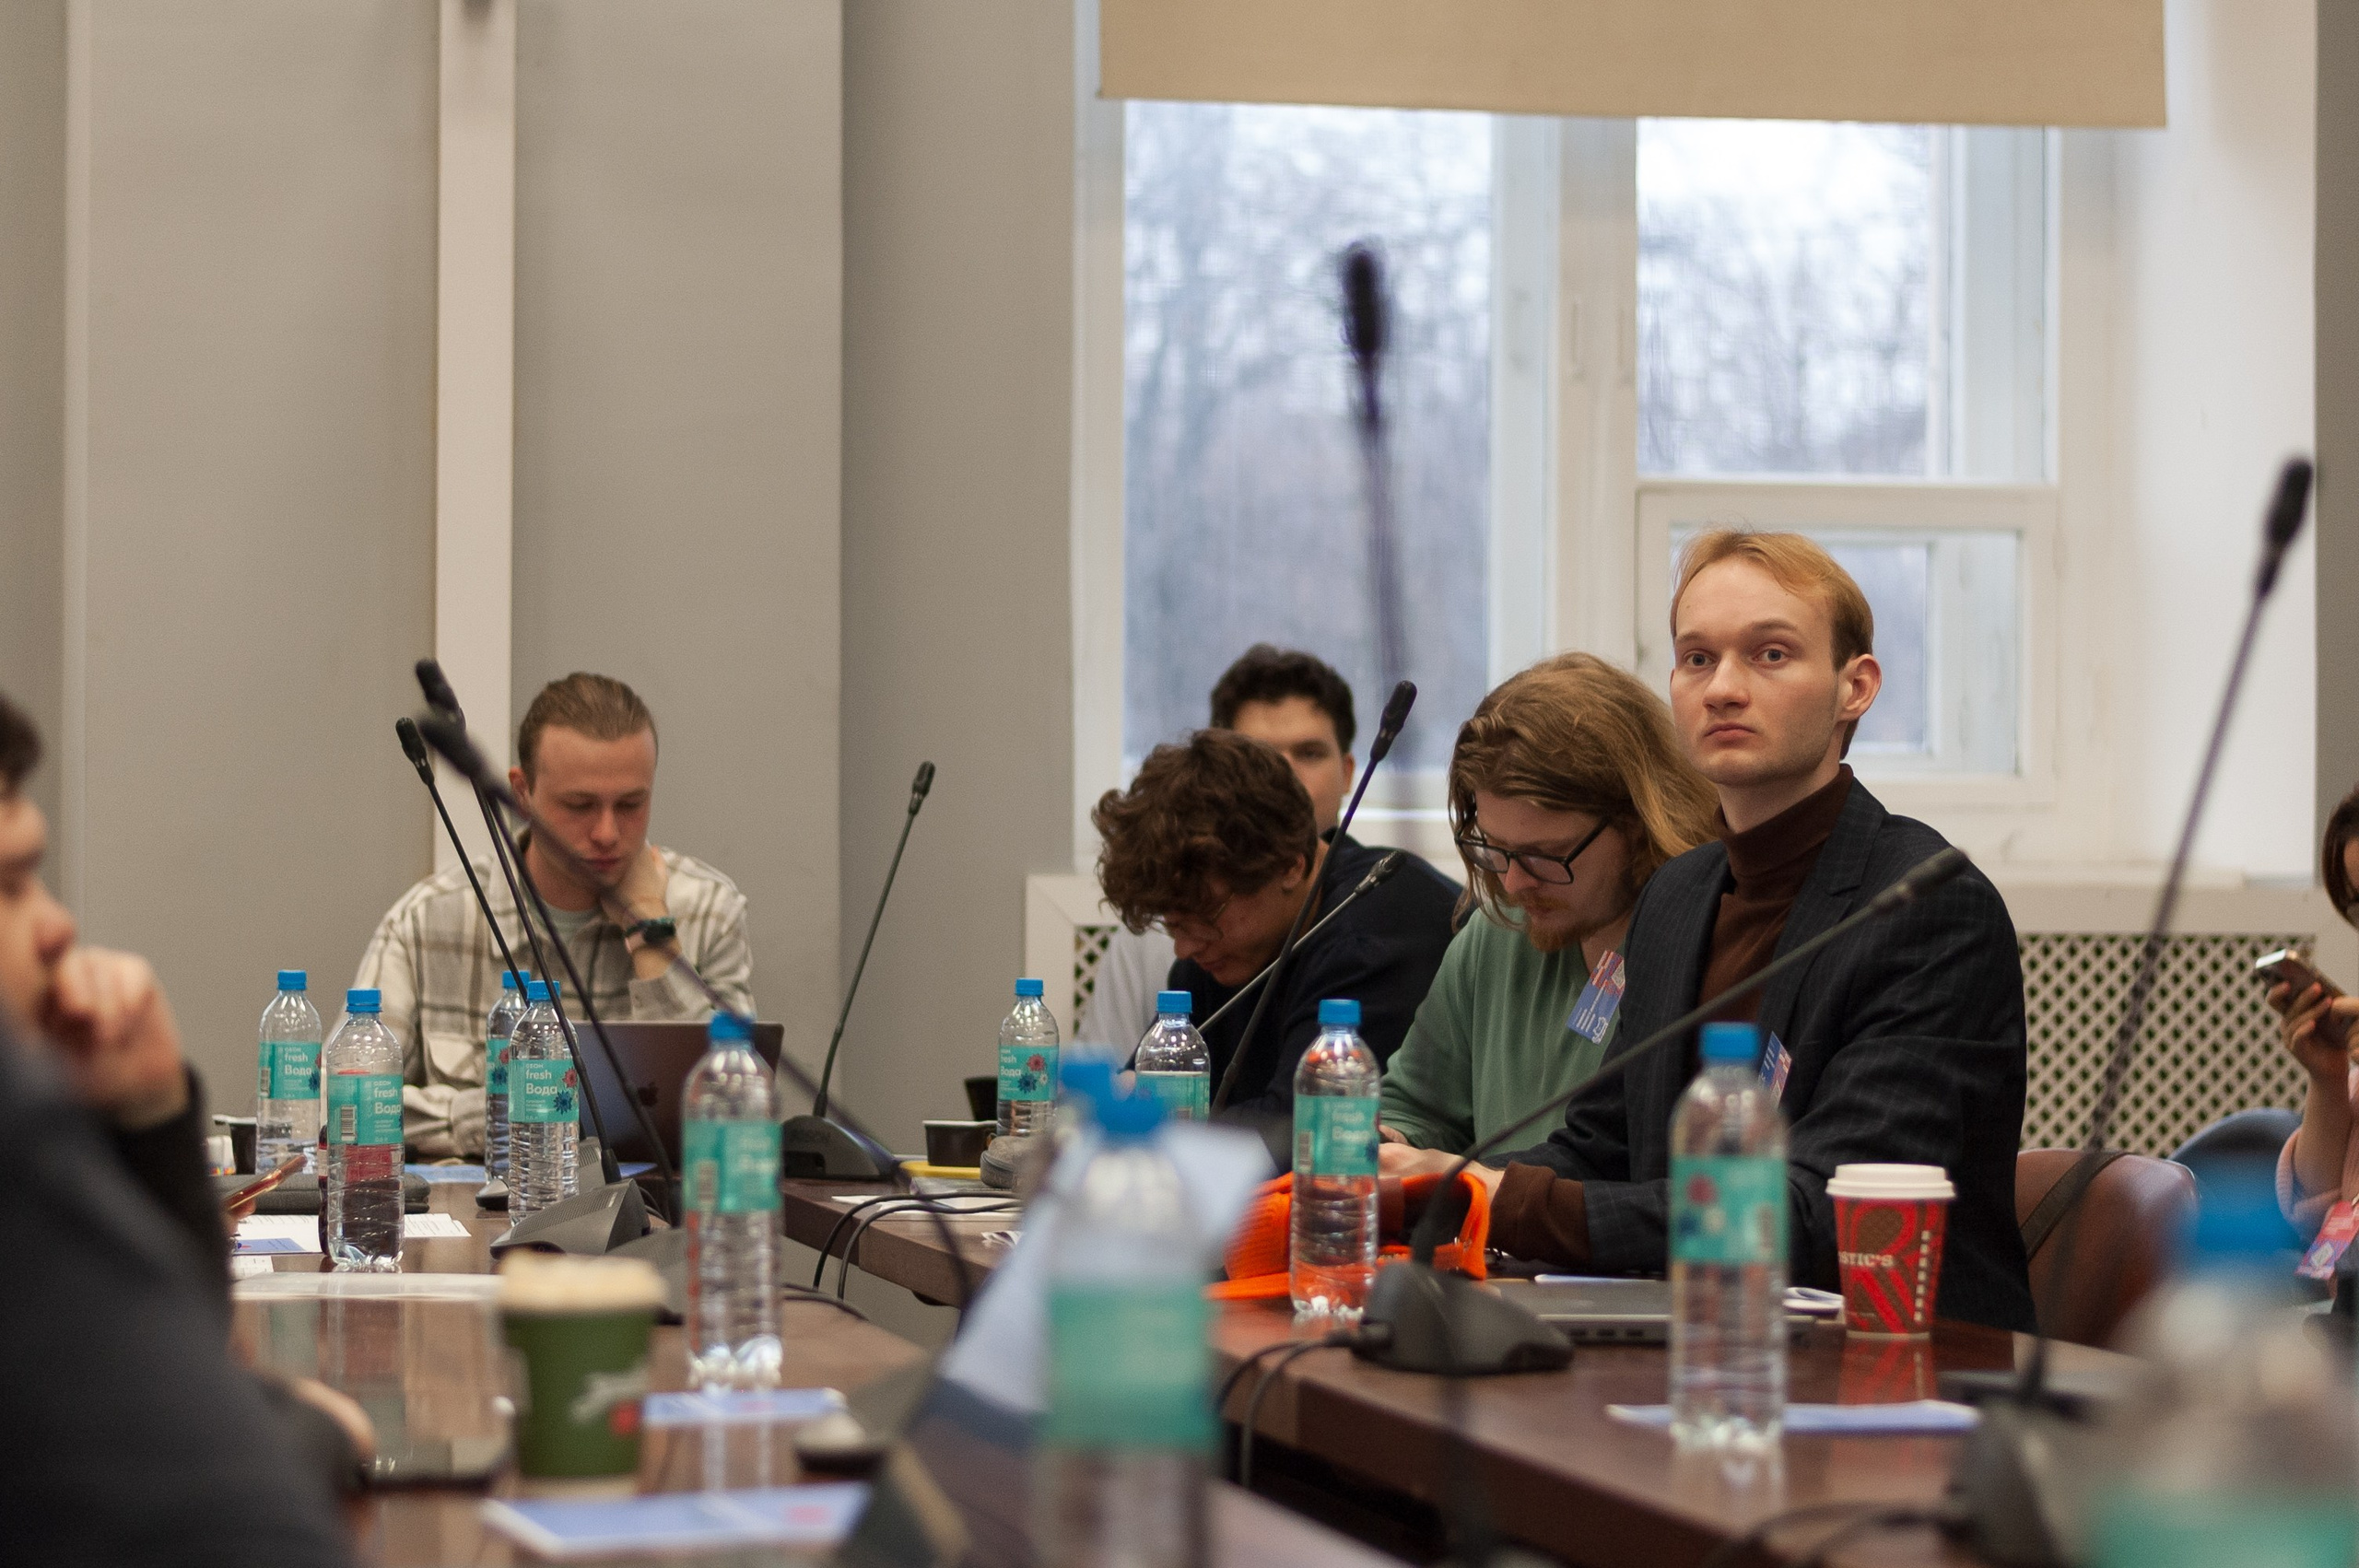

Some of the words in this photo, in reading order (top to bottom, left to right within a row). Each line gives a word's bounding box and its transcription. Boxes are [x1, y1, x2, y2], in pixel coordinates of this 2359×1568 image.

[284, 1052, 309, 1062] fresh
[284, 1064, 312, 1076] Вода
[525, 1070, 552, 1080] fresh
[374, 1087, 398, 1098] fresh
[525, 1082, 557, 1095] Вода
[374, 1102, 402, 1115] Вода
